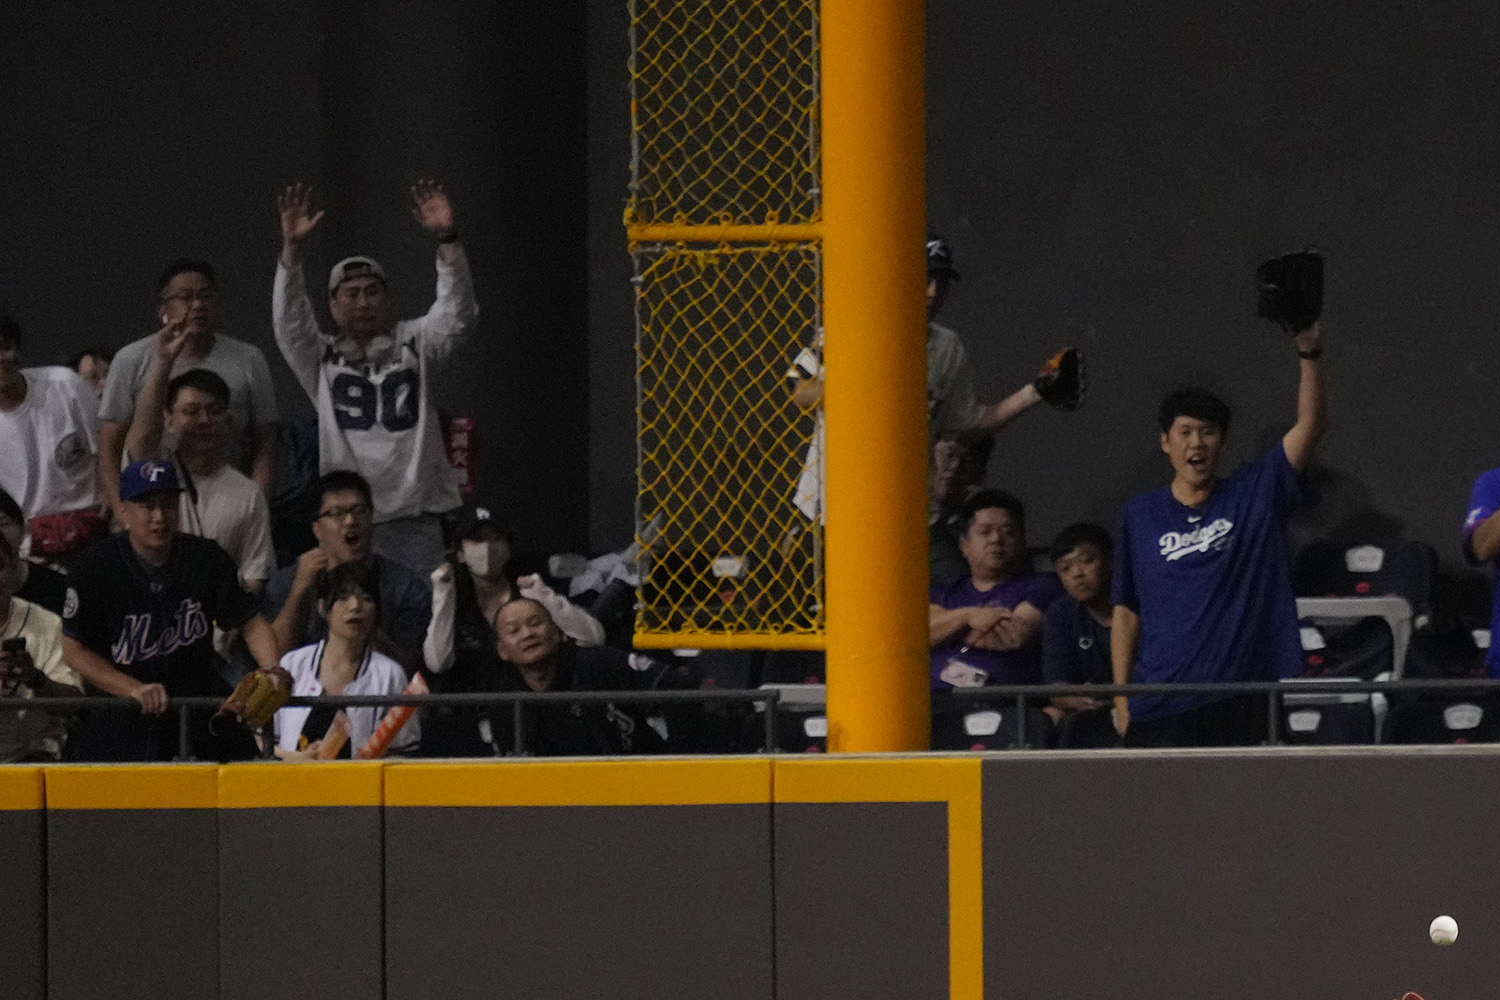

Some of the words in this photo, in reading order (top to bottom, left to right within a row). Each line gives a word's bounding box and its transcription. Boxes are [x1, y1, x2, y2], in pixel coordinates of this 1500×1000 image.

[333, 369, 420, 432] 90
[1159, 518, 1234, 562] Dodgers
[111, 598, 209, 665] Mets
